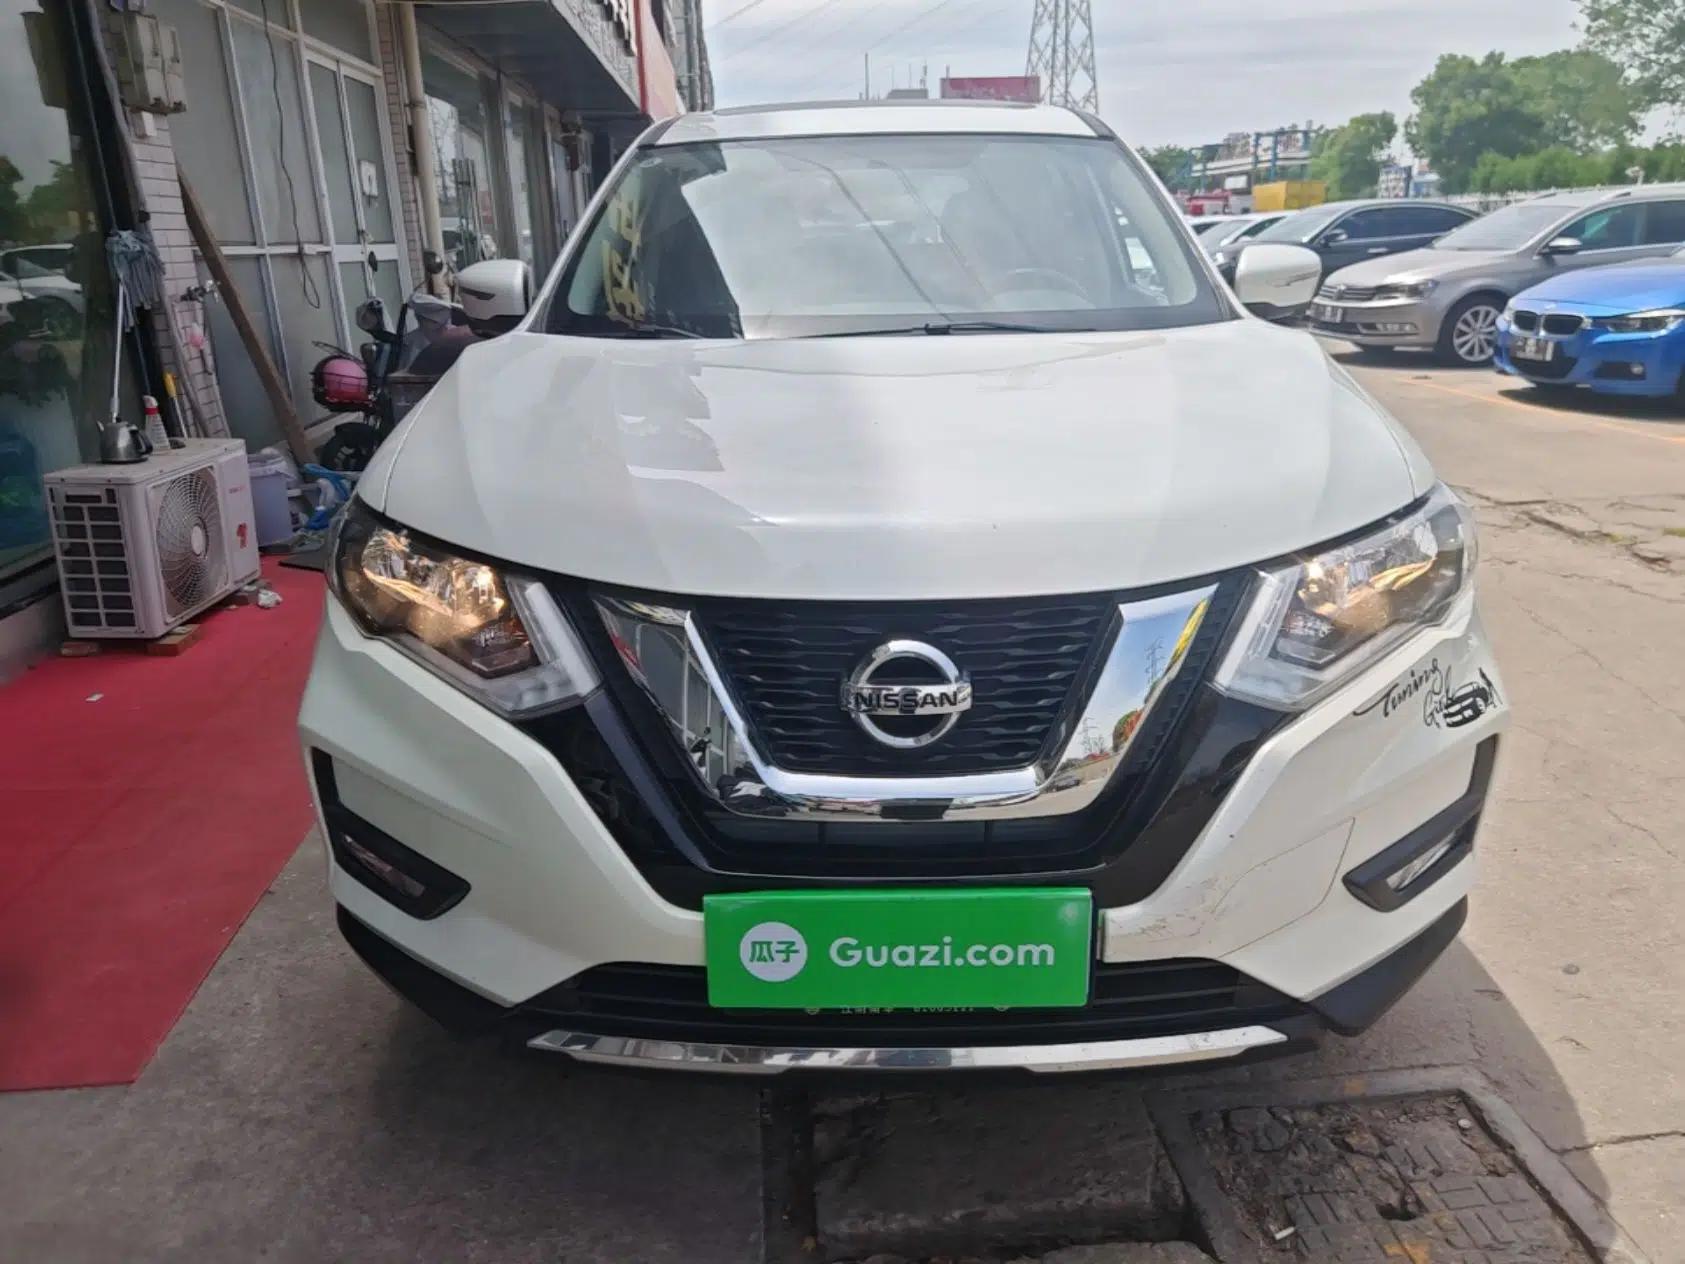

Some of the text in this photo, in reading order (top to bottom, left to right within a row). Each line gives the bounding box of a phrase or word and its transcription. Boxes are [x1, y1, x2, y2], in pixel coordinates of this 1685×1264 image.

[854, 691, 958, 710] NISSAN
[1353, 658, 1443, 717] Tuning
[750, 940, 801, 963] 瓜子
[829, 936, 1055, 967] Guazi.com
